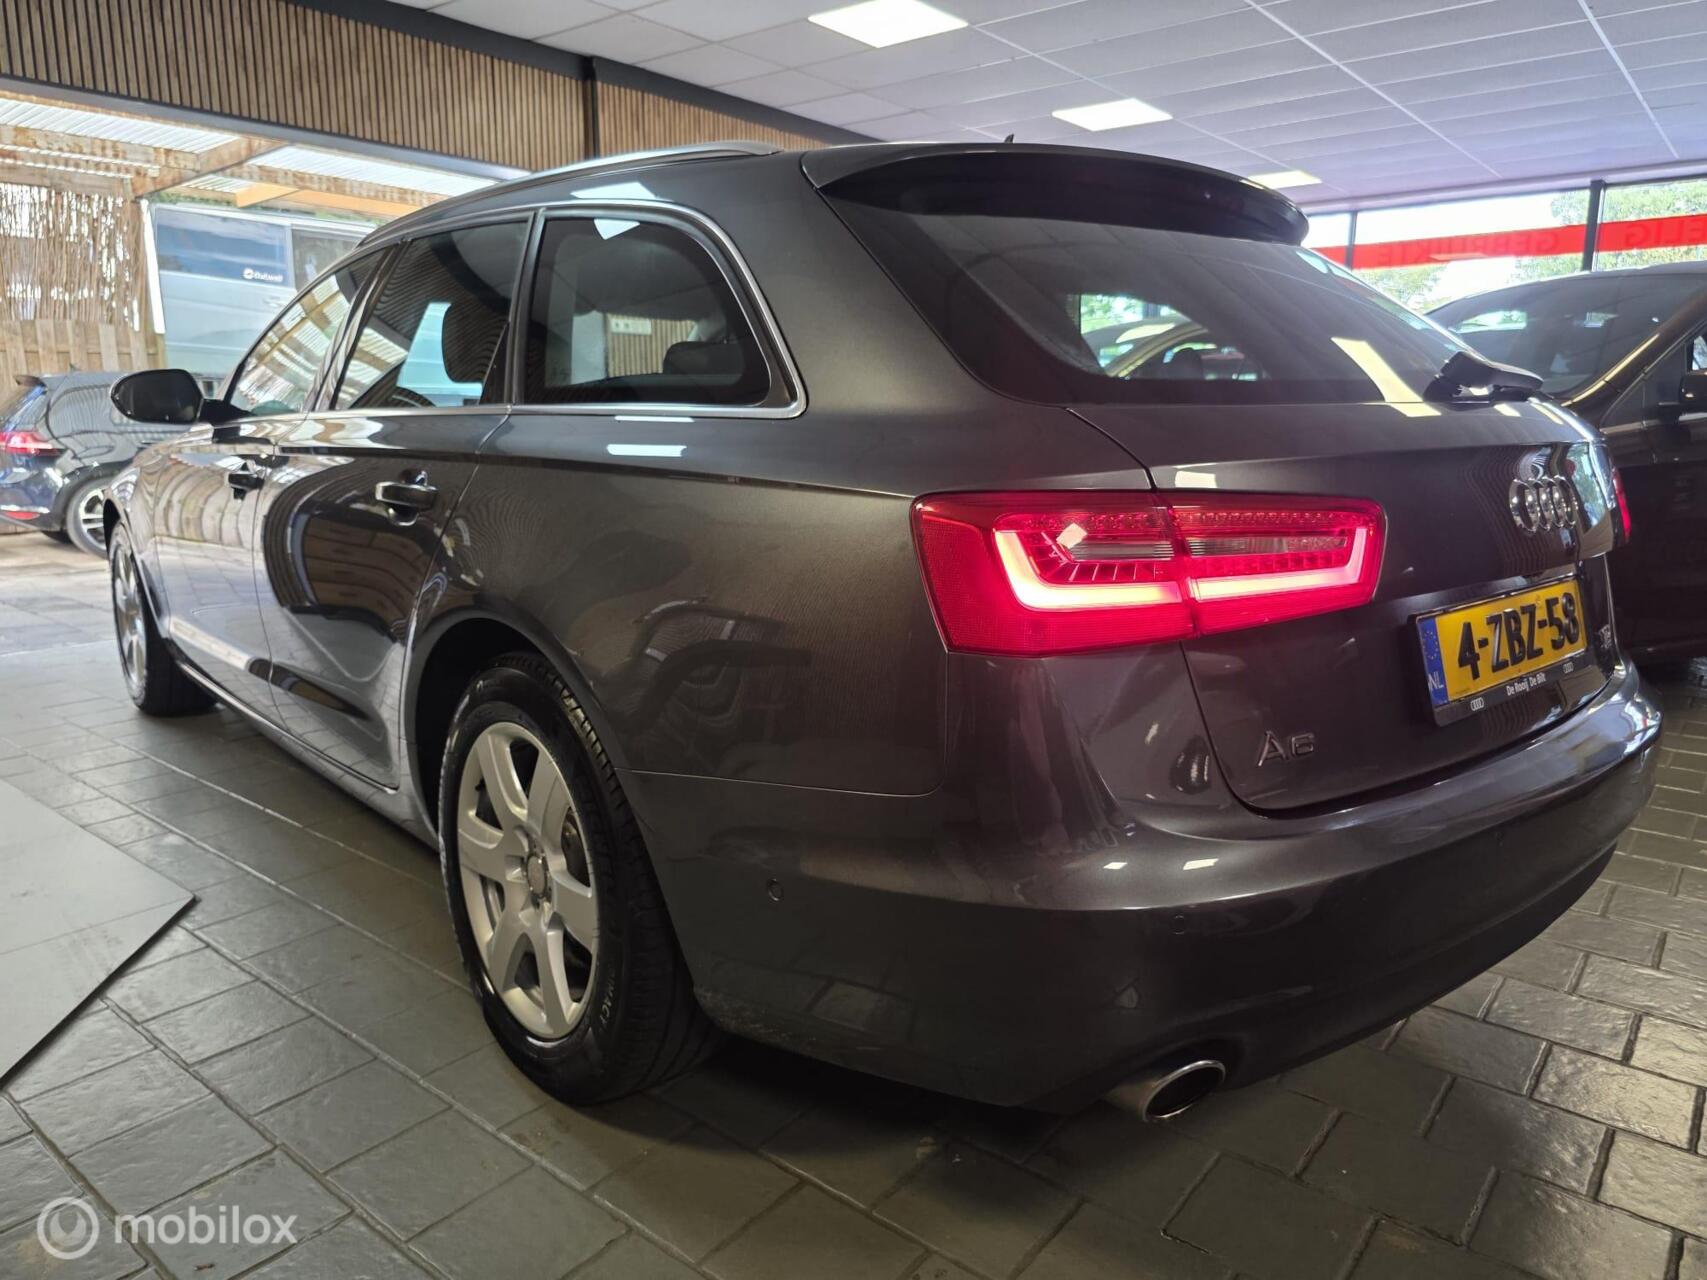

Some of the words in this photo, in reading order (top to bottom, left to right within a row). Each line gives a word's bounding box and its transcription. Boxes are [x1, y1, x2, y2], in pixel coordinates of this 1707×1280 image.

[1457, 592, 1580, 680] 4-ZBZ-58
[1428, 662, 1444, 689] NL
[1506, 685, 1515, 697] De
[1257, 730, 1315, 767] A6
